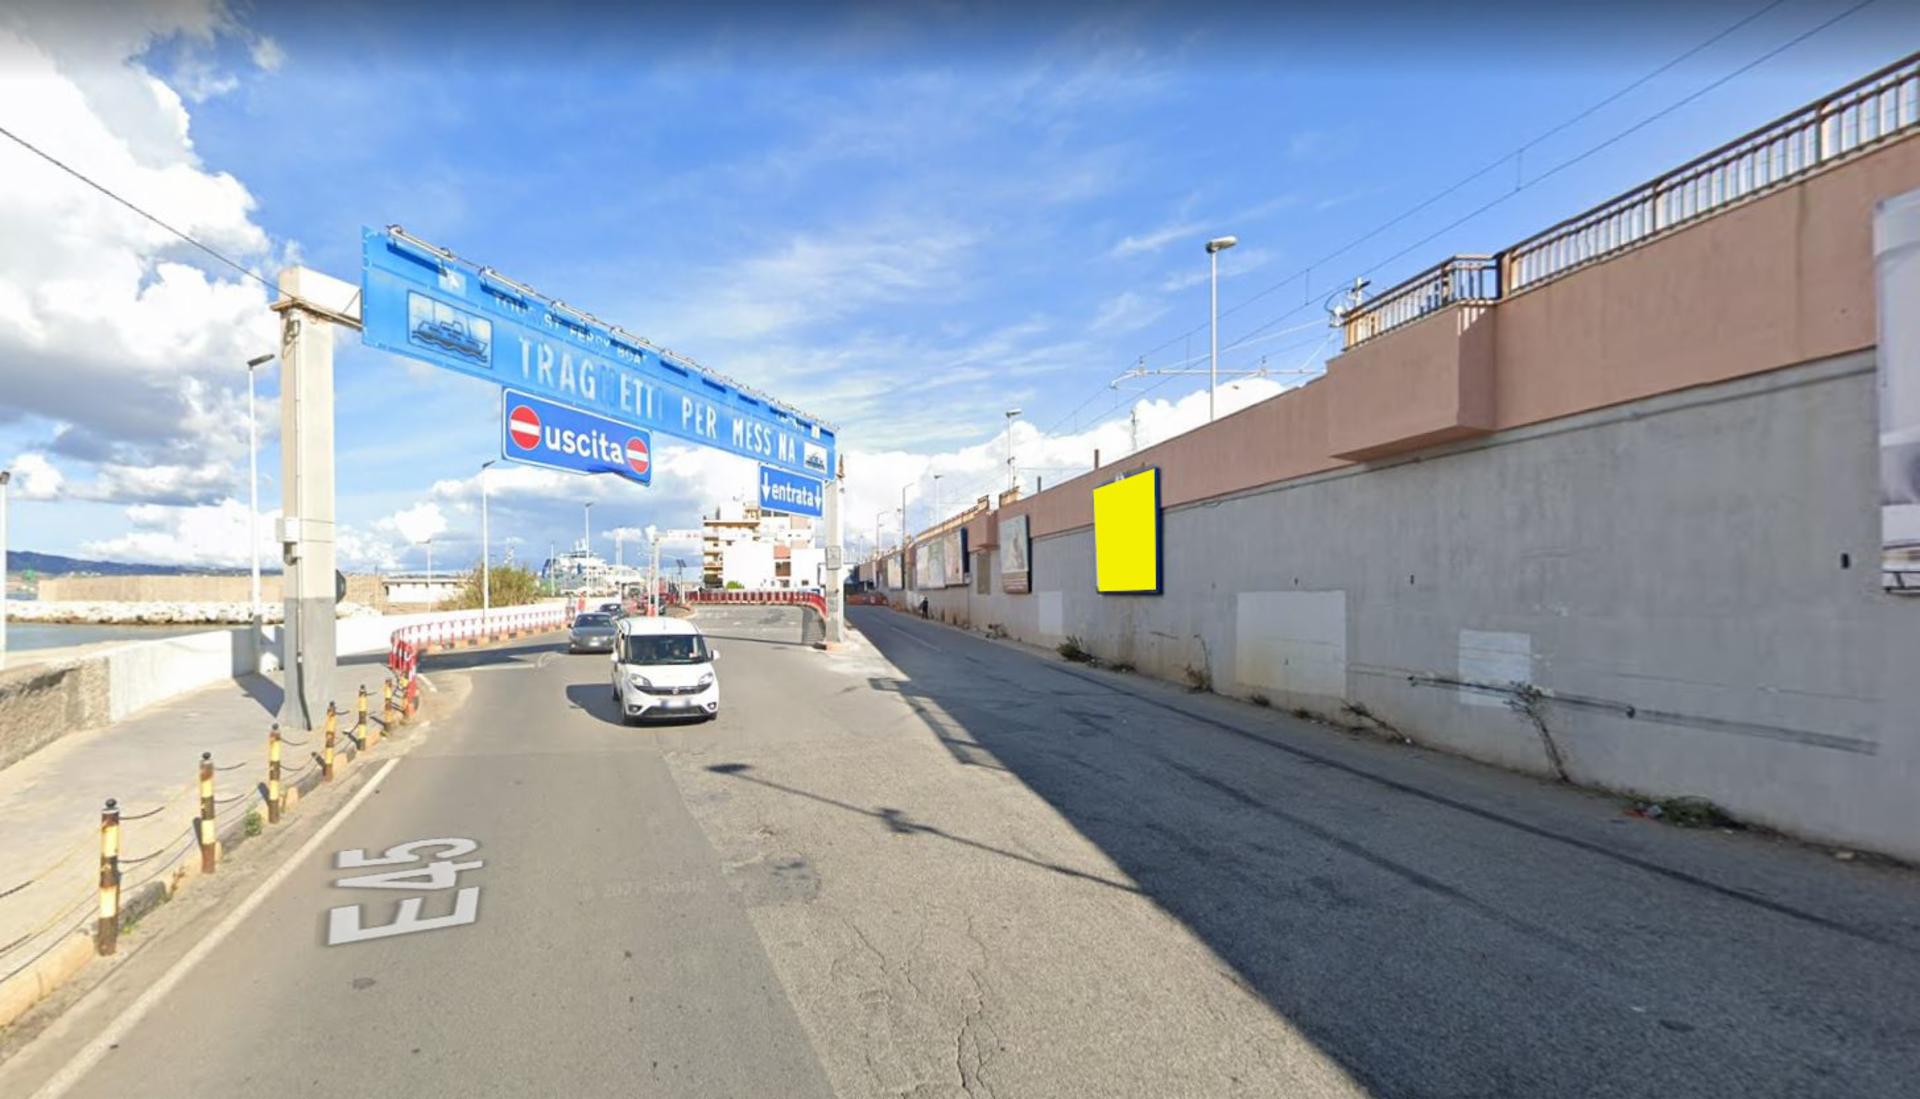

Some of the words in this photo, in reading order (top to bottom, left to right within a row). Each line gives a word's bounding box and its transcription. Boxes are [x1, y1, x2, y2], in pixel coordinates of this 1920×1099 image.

[682, 396, 717, 440] PER
[545, 425, 625, 465] uscita
[771, 482, 814, 508] entrata
